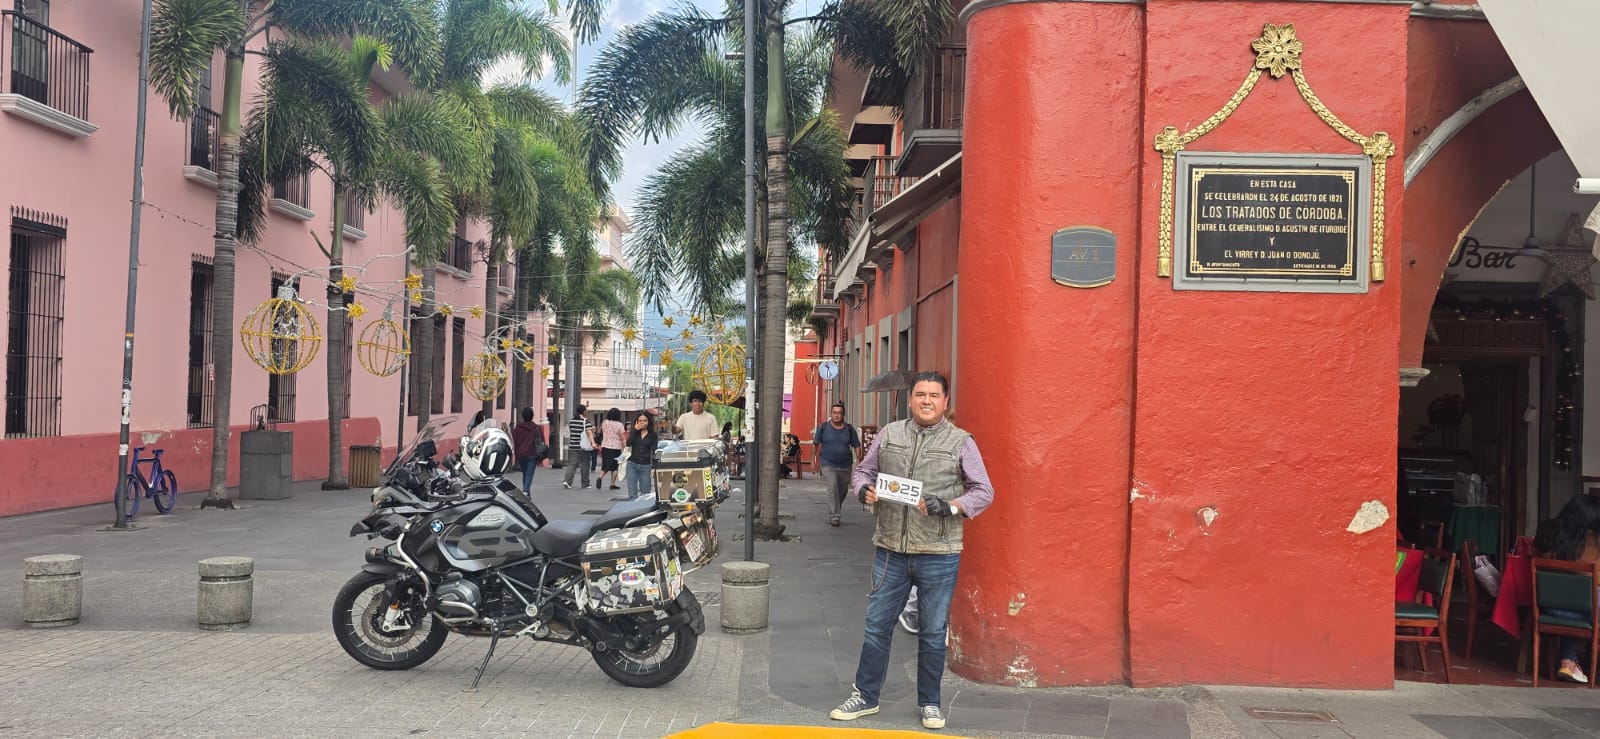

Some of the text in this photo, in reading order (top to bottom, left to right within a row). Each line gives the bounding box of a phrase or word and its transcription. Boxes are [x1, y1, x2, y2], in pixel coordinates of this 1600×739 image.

[1250, 180, 1296, 189] EN ESTA CASA
[1204, 192, 1343, 203] SE CELEBRARON EL 24 DE AGOSTO DE 1821
[1202, 205, 1222, 218] LOS
[1225, 206, 1276, 219] TRATADOS
[1279, 207, 1292, 219] DE
[1197, 223, 1217, 231] ENTRE
[1219, 223, 1227, 232] EL
[1309, 225, 1318, 233] DE
[1320, 225, 1348, 234] ITURBIDE
[1269, 236, 1275, 246] Y
[1224, 249, 1233, 258] EL
[1235, 250, 1259, 258] VIRREY
[1267, 250, 1284, 259] JUAN
[1449, 236, 1516, 269] Bar
[900, 483, 920, 497] 25
